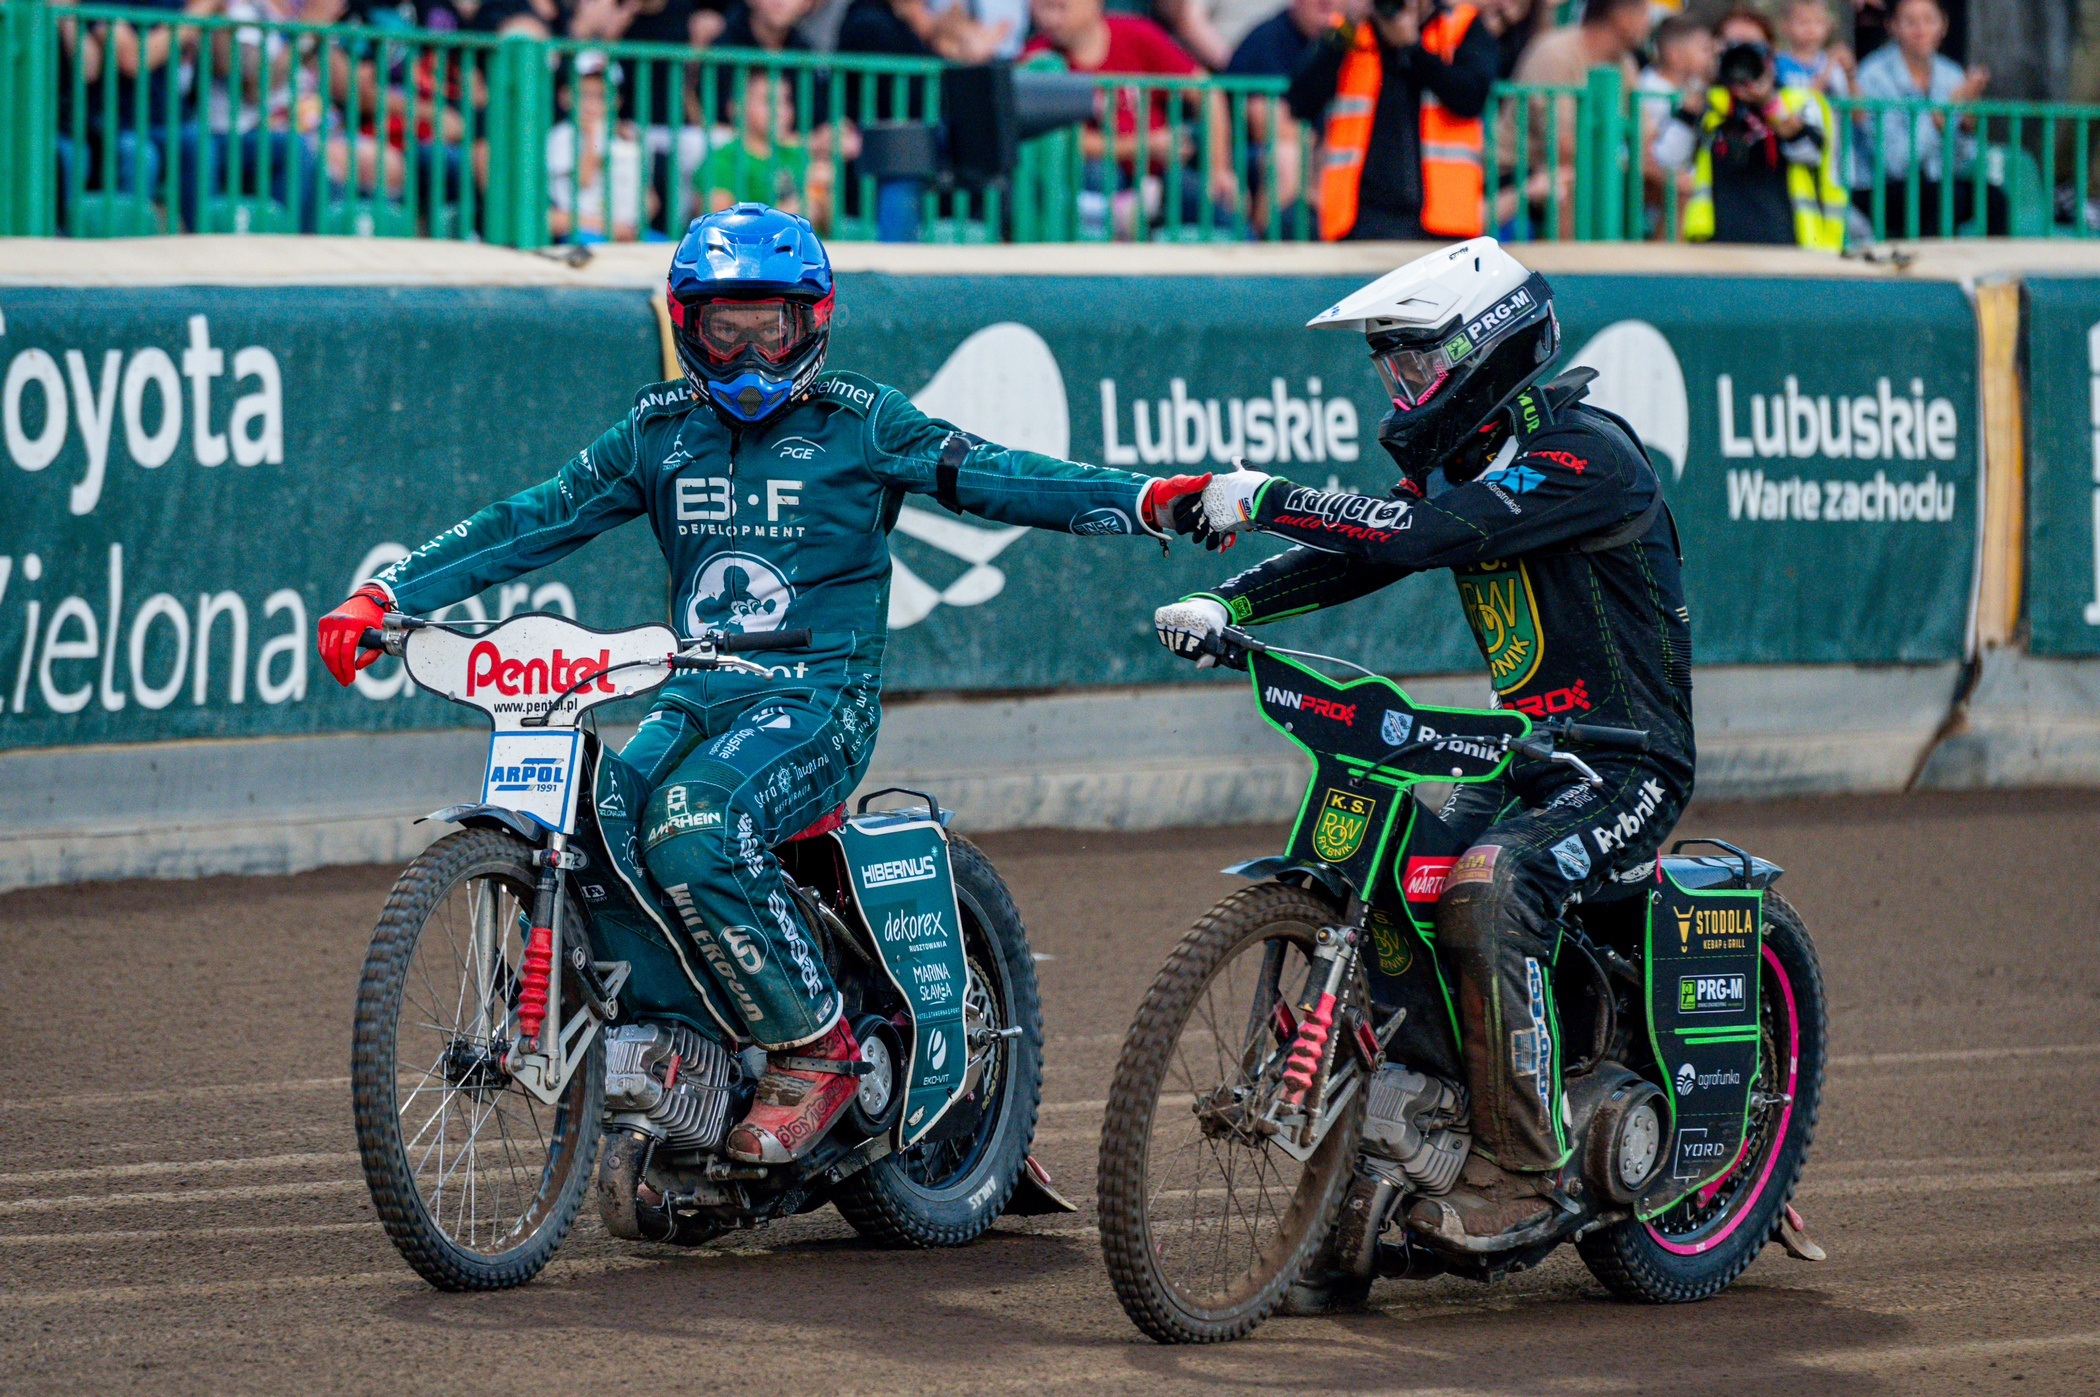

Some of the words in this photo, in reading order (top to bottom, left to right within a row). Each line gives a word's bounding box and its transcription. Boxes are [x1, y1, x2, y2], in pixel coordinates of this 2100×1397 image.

[1466, 290, 1530, 340] PRG-M
[0, 310, 284, 516] oyota
[1100, 377, 1360, 464] Lubuskie
[1716, 373, 1957, 460] Lubuskie
[779, 447, 815, 460] PGE
[1726, 467, 1820, 521] Warte
[1823, 467, 1956, 522] zachodu
[678, 523, 806, 538] DEVELOPMENT
[1273, 513, 1323, 529] auto
[0, 542, 306, 714] ielona
[466, 640, 616, 697] Pentel
[490, 766, 564, 783] ARPOL
[536, 784, 557, 793] 1991
[1591, 777, 1666, 854] Rybnik
[1317, 835, 1353, 857] RYBNIK
[861, 855, 937, 889] HIBERNUS
[884, 908, 948, 943] dekorex
[1696, 909, 1753, 935] STODOLA
[908, 940, 948, 953] RUSZTOWANIA
[1703, 939, 1722, 950] KEBAP
[1727, 938, 1746, 949] GRILL
[913, 962, 951, 984] MARINA
[1696, 978, 1743, 1000] PRG-M
[922, 1073, 950, 1086] EKO-VIT
[1697, 1068, 1740, 1090] agrofunka
[775, 1076, 845, 1147] daytona
[1683, 1143, 1725, 1157] YORD
